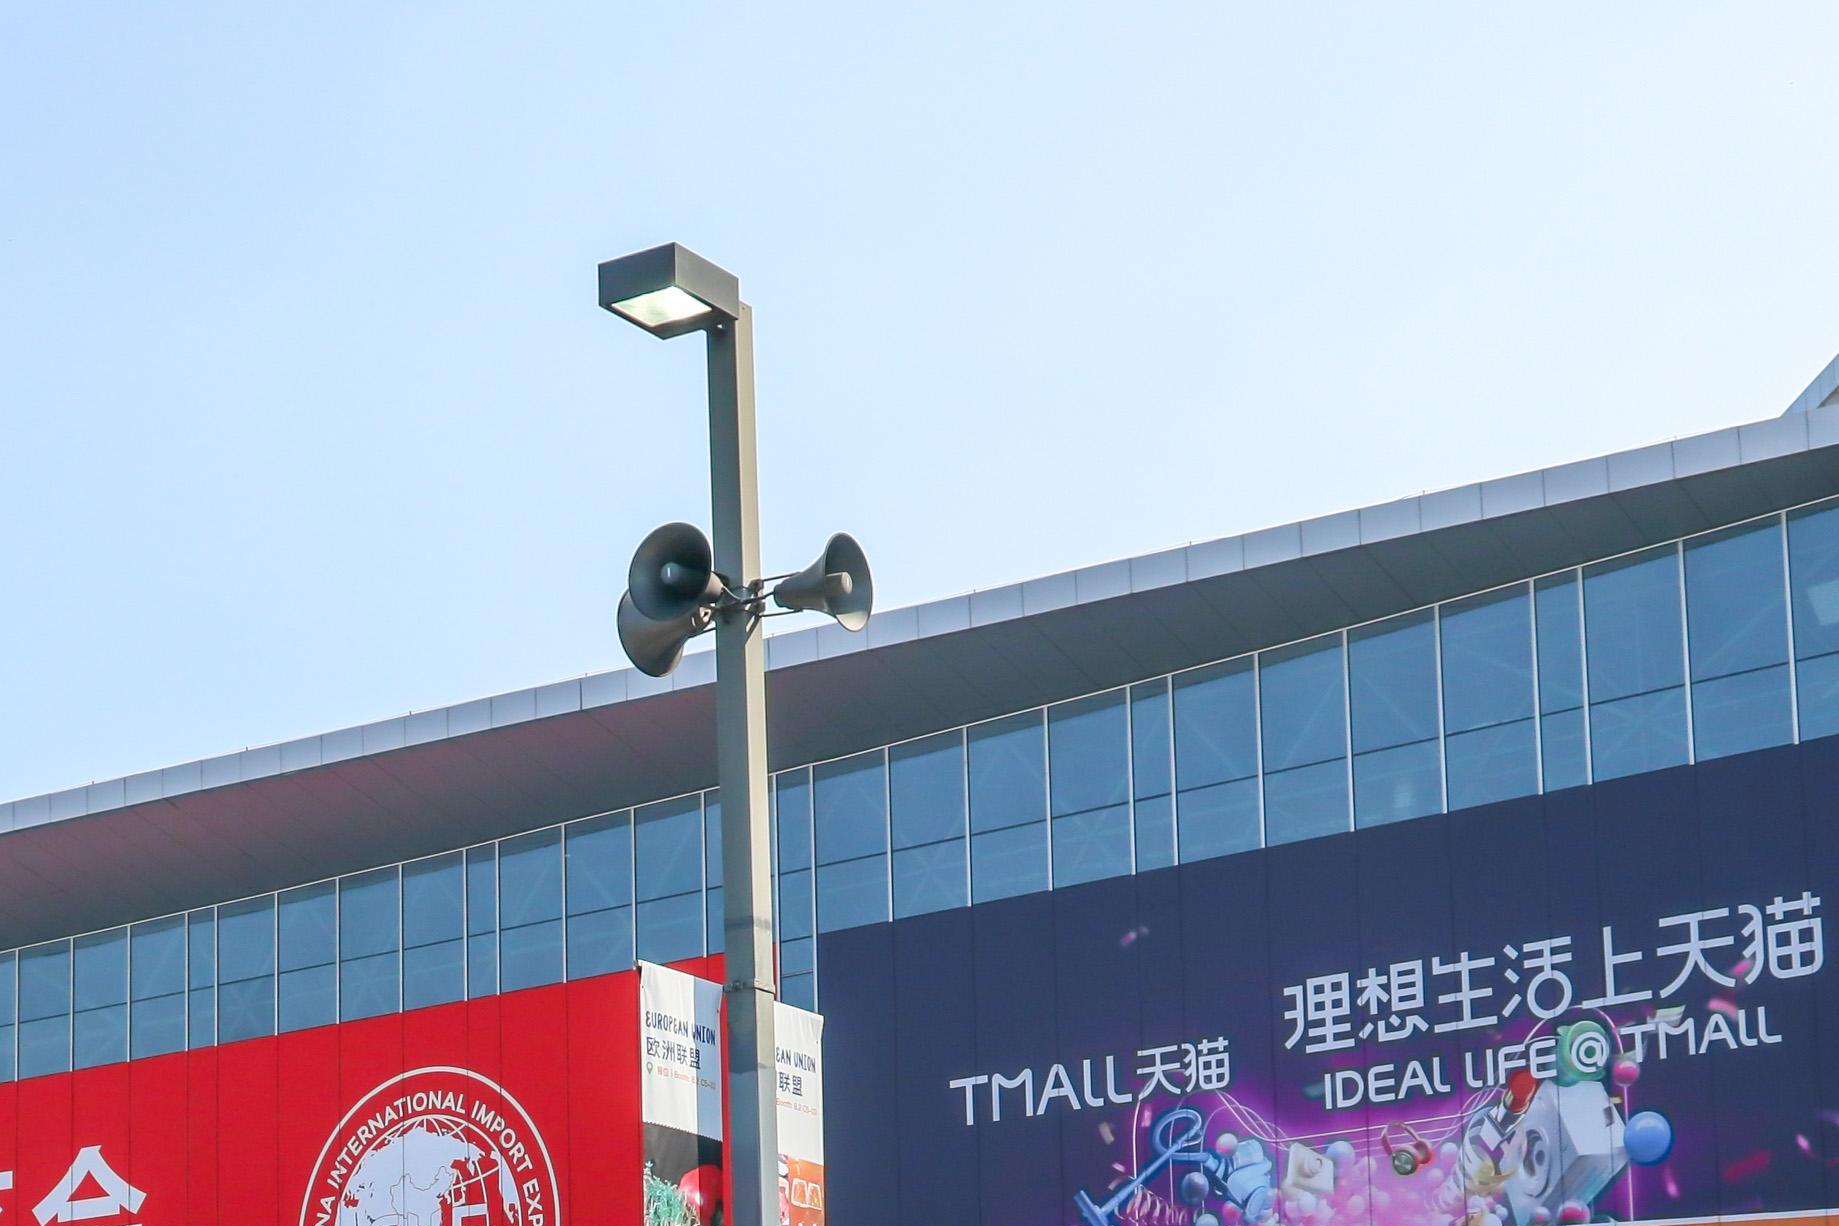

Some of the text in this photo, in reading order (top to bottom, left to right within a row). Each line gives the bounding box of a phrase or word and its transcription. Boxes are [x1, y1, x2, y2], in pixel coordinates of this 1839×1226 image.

[1283, 891, 1823, 1054] 理想生活上天猫
[645, 1010, 716, 1046] EUROPEAN UNION
[646, 1036, 701, 1070] 欧洲联盟
[793, 1051, 816, 1073] UNION
[1324, 1056, 1451, 1111] IDEAL
[1464, 1038, 1559, 1090] LIFE
[1620, 1006, 1782, 1064] TMALL
[326, 1090, 466, 1190] INTERNATIONAL
[471, 1100, 534, 1173] IMPORT
